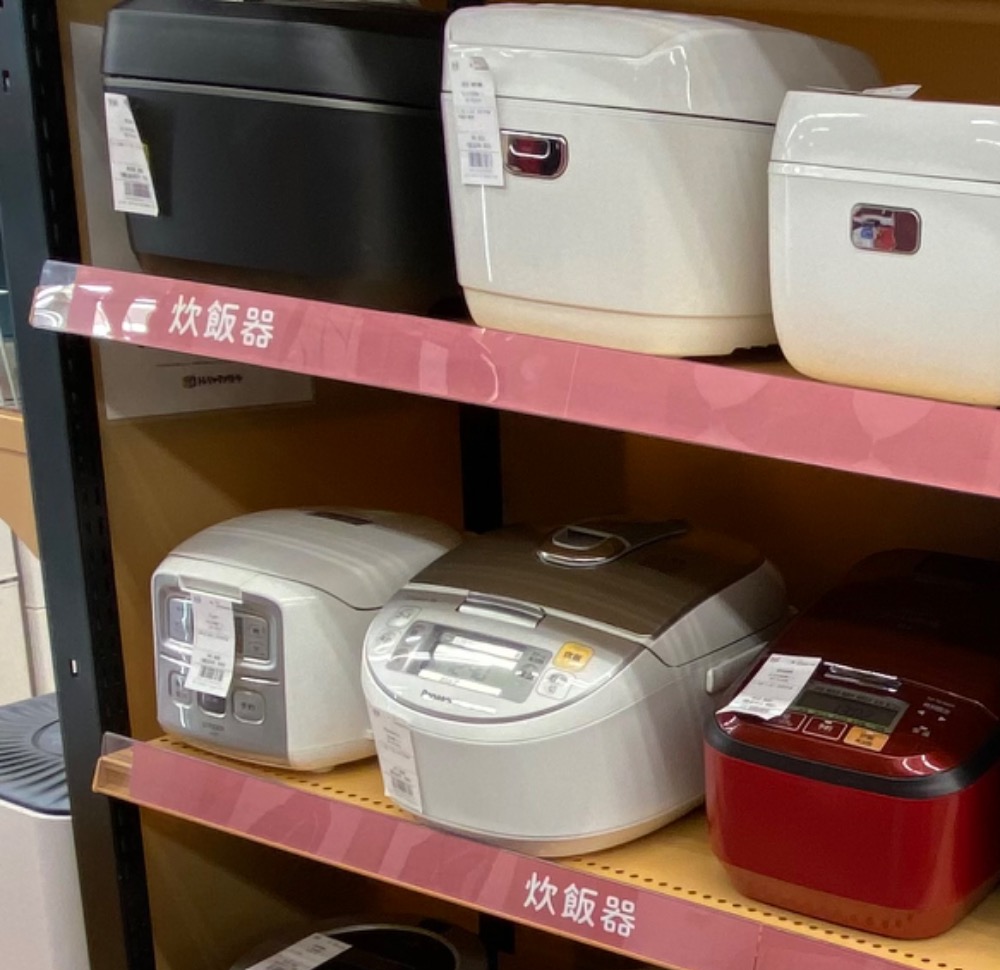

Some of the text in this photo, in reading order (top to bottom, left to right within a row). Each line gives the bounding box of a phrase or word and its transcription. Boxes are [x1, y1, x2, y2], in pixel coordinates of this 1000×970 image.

[168, 294, 275, 348] 炊飯器
[523, 871, 636, 938] 炊飯器
